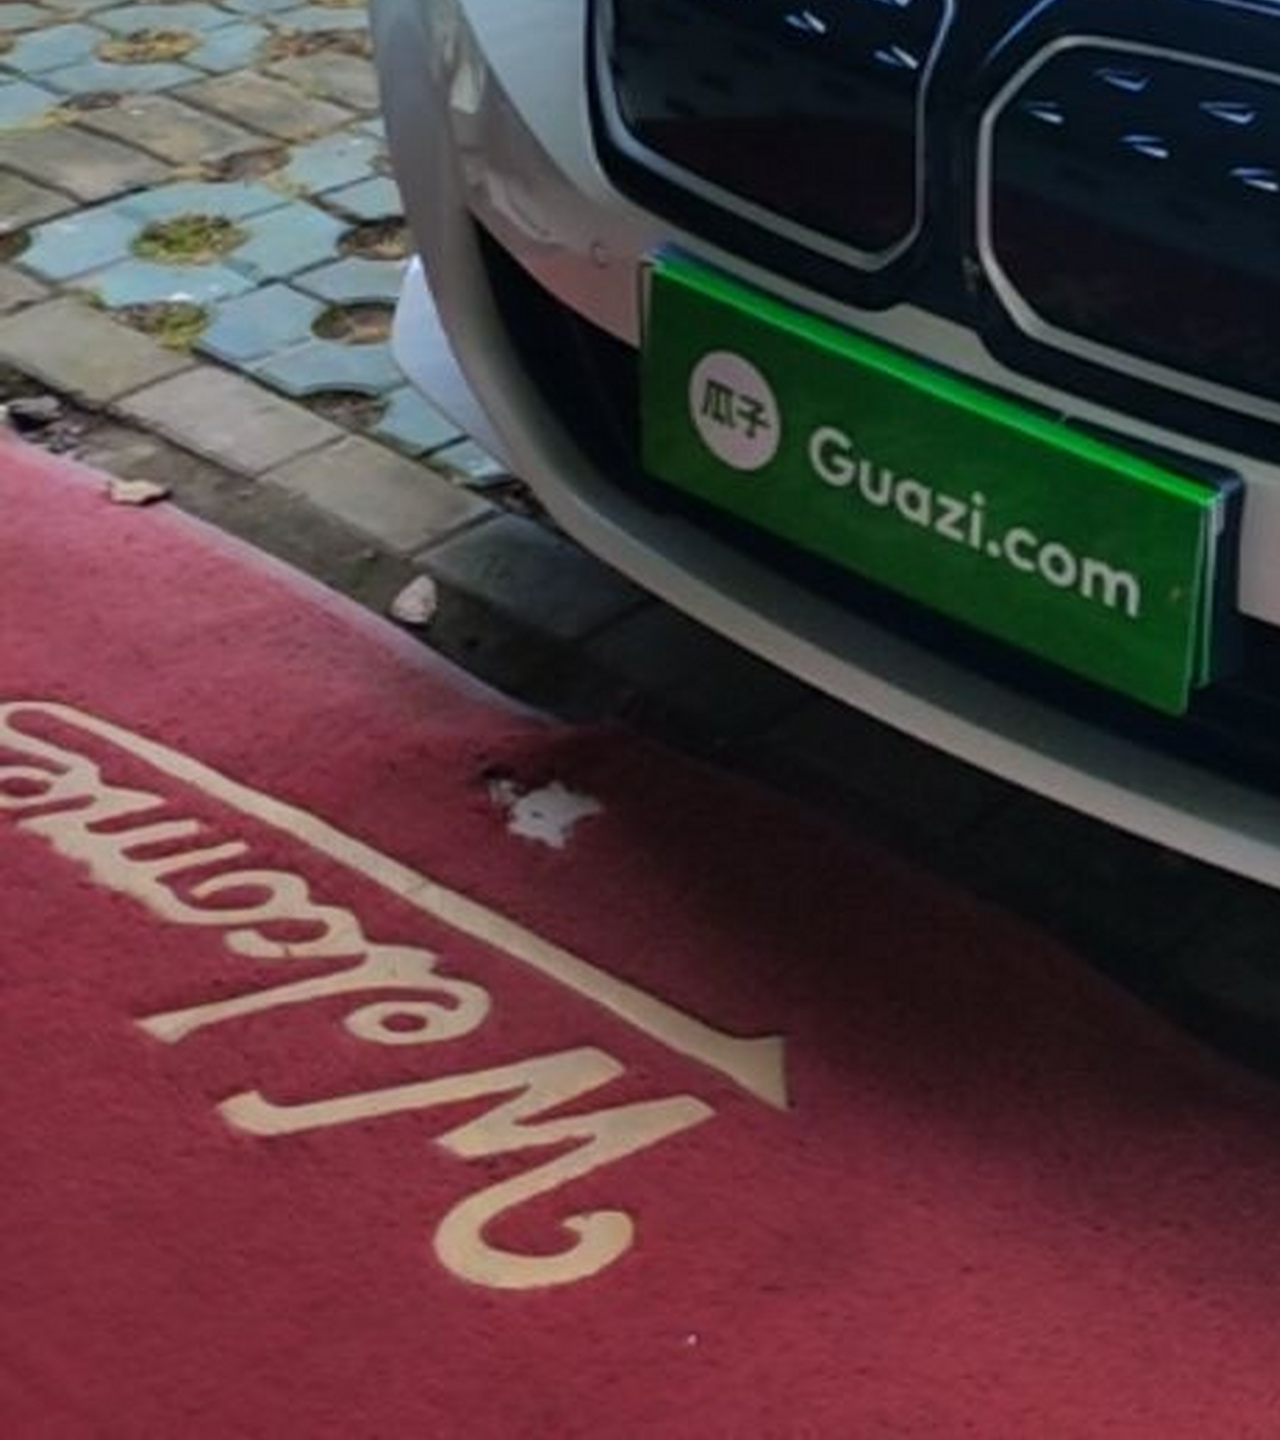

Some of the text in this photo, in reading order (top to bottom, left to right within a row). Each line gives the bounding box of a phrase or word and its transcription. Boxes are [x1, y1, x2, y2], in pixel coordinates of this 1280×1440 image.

[702, 378, 770, 439] 瓜子
[808, 425, 1141, 619] Guazi.com
[0, 703, 717, 1289] Welcome
